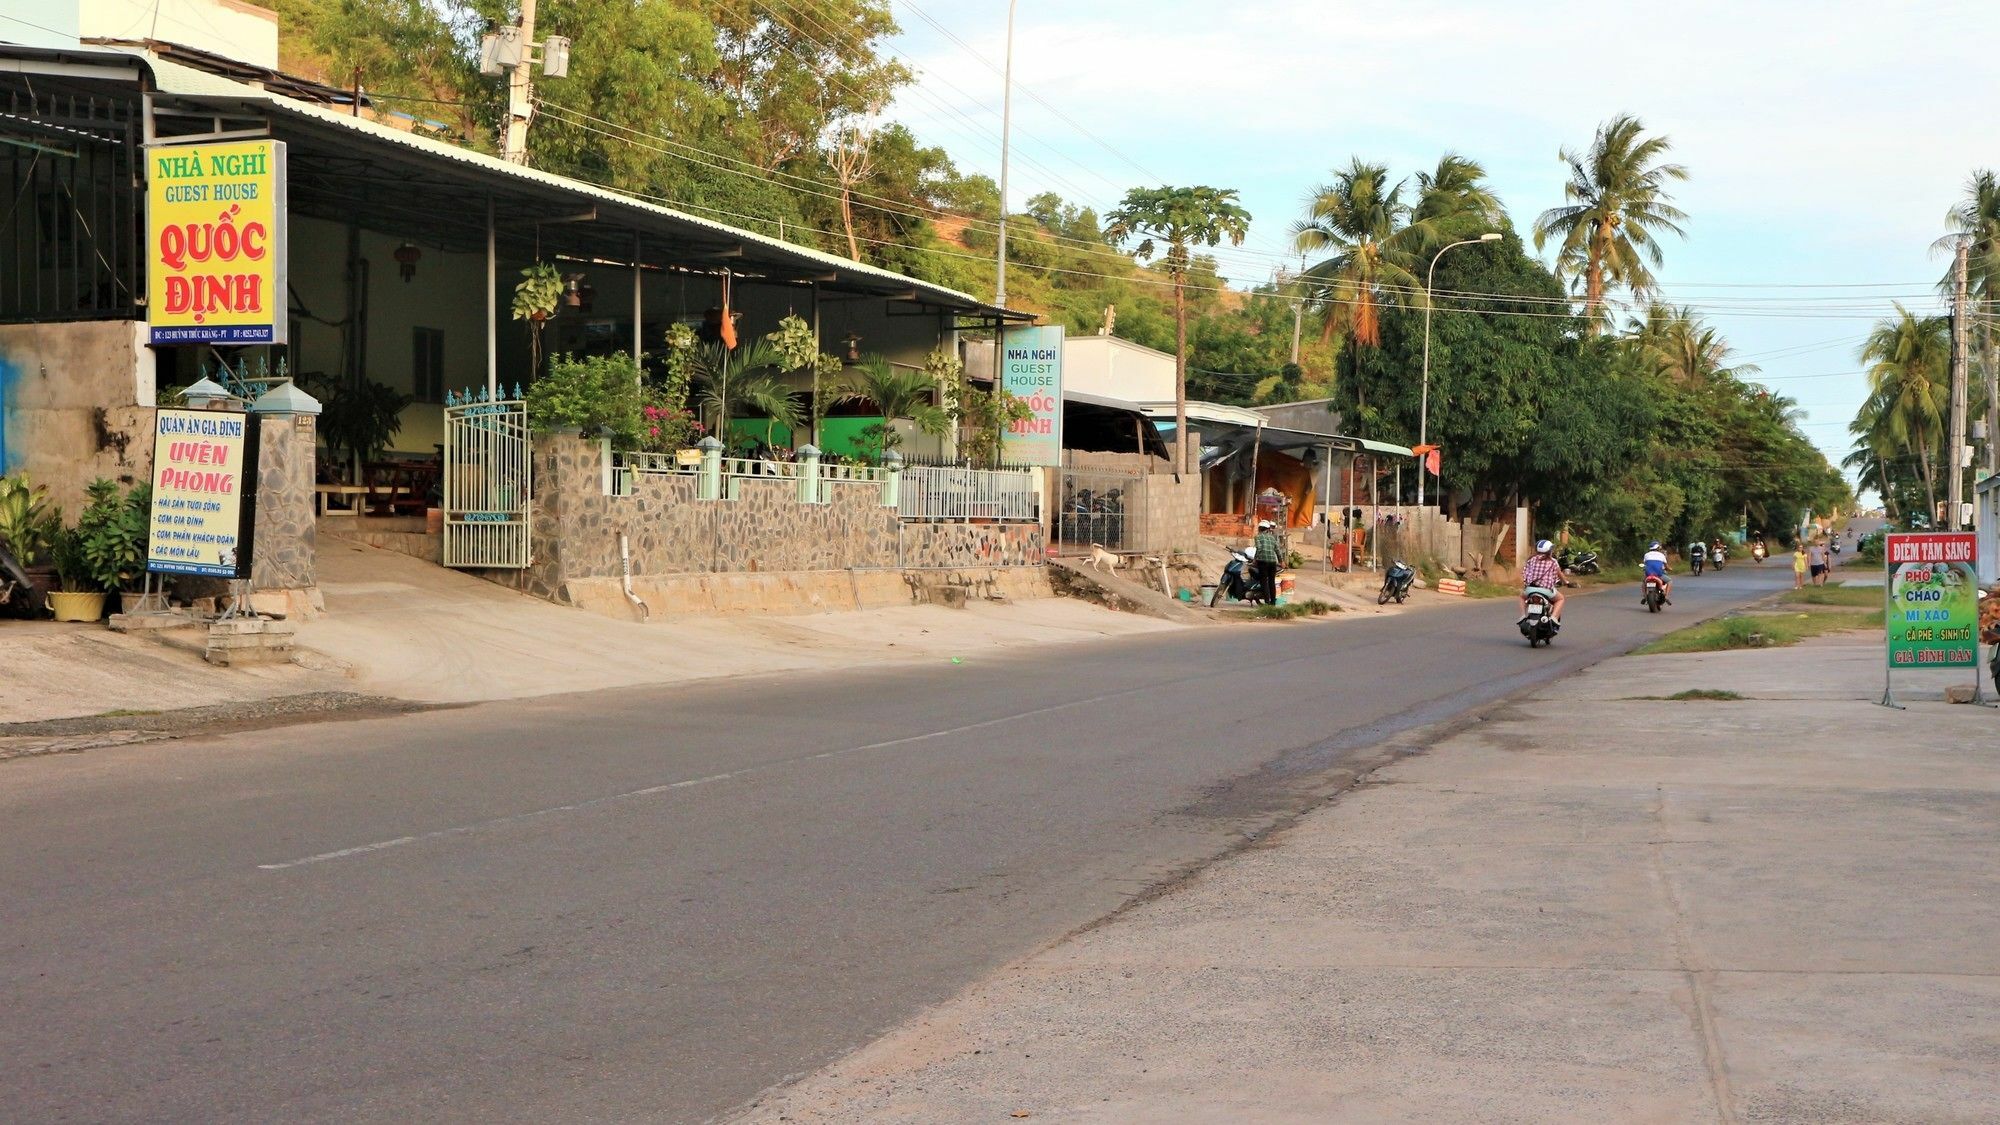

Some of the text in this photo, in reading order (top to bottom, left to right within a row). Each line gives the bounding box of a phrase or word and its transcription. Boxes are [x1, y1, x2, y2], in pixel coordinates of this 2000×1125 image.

[158, 146, 266, 178] NHÀ NGHỈ
[166, 183, 258, 202] GUEST HOUSE
[160, 204, 266, 271] QUỐC
[165, 274, 262, 324] ĐỊNH
[1008, 345, 1056, 360] NHÀ NGHỈ
[1011, 364, 1053, 373] GUEST
[1010, 376, 1053, 386] HOUSE
[160, 413, 185, 434] QUÁN
[202, 420, 216, 435] GIA
[220, 417, 242, 436] ĐÌNH
[170, 440, 228, 464] UYÊN
[160, 468, 233, 492] PHONG
[174, 516, 185, 524] GIA
[1894, 537, 1971, 561] ĐIỂM TÂM SÁNG
[1940, 629, 1958, 640] SINH
[1960, 624, 1970, 640] TỐ
[1918, 646, 1945, 662] BÌNH
